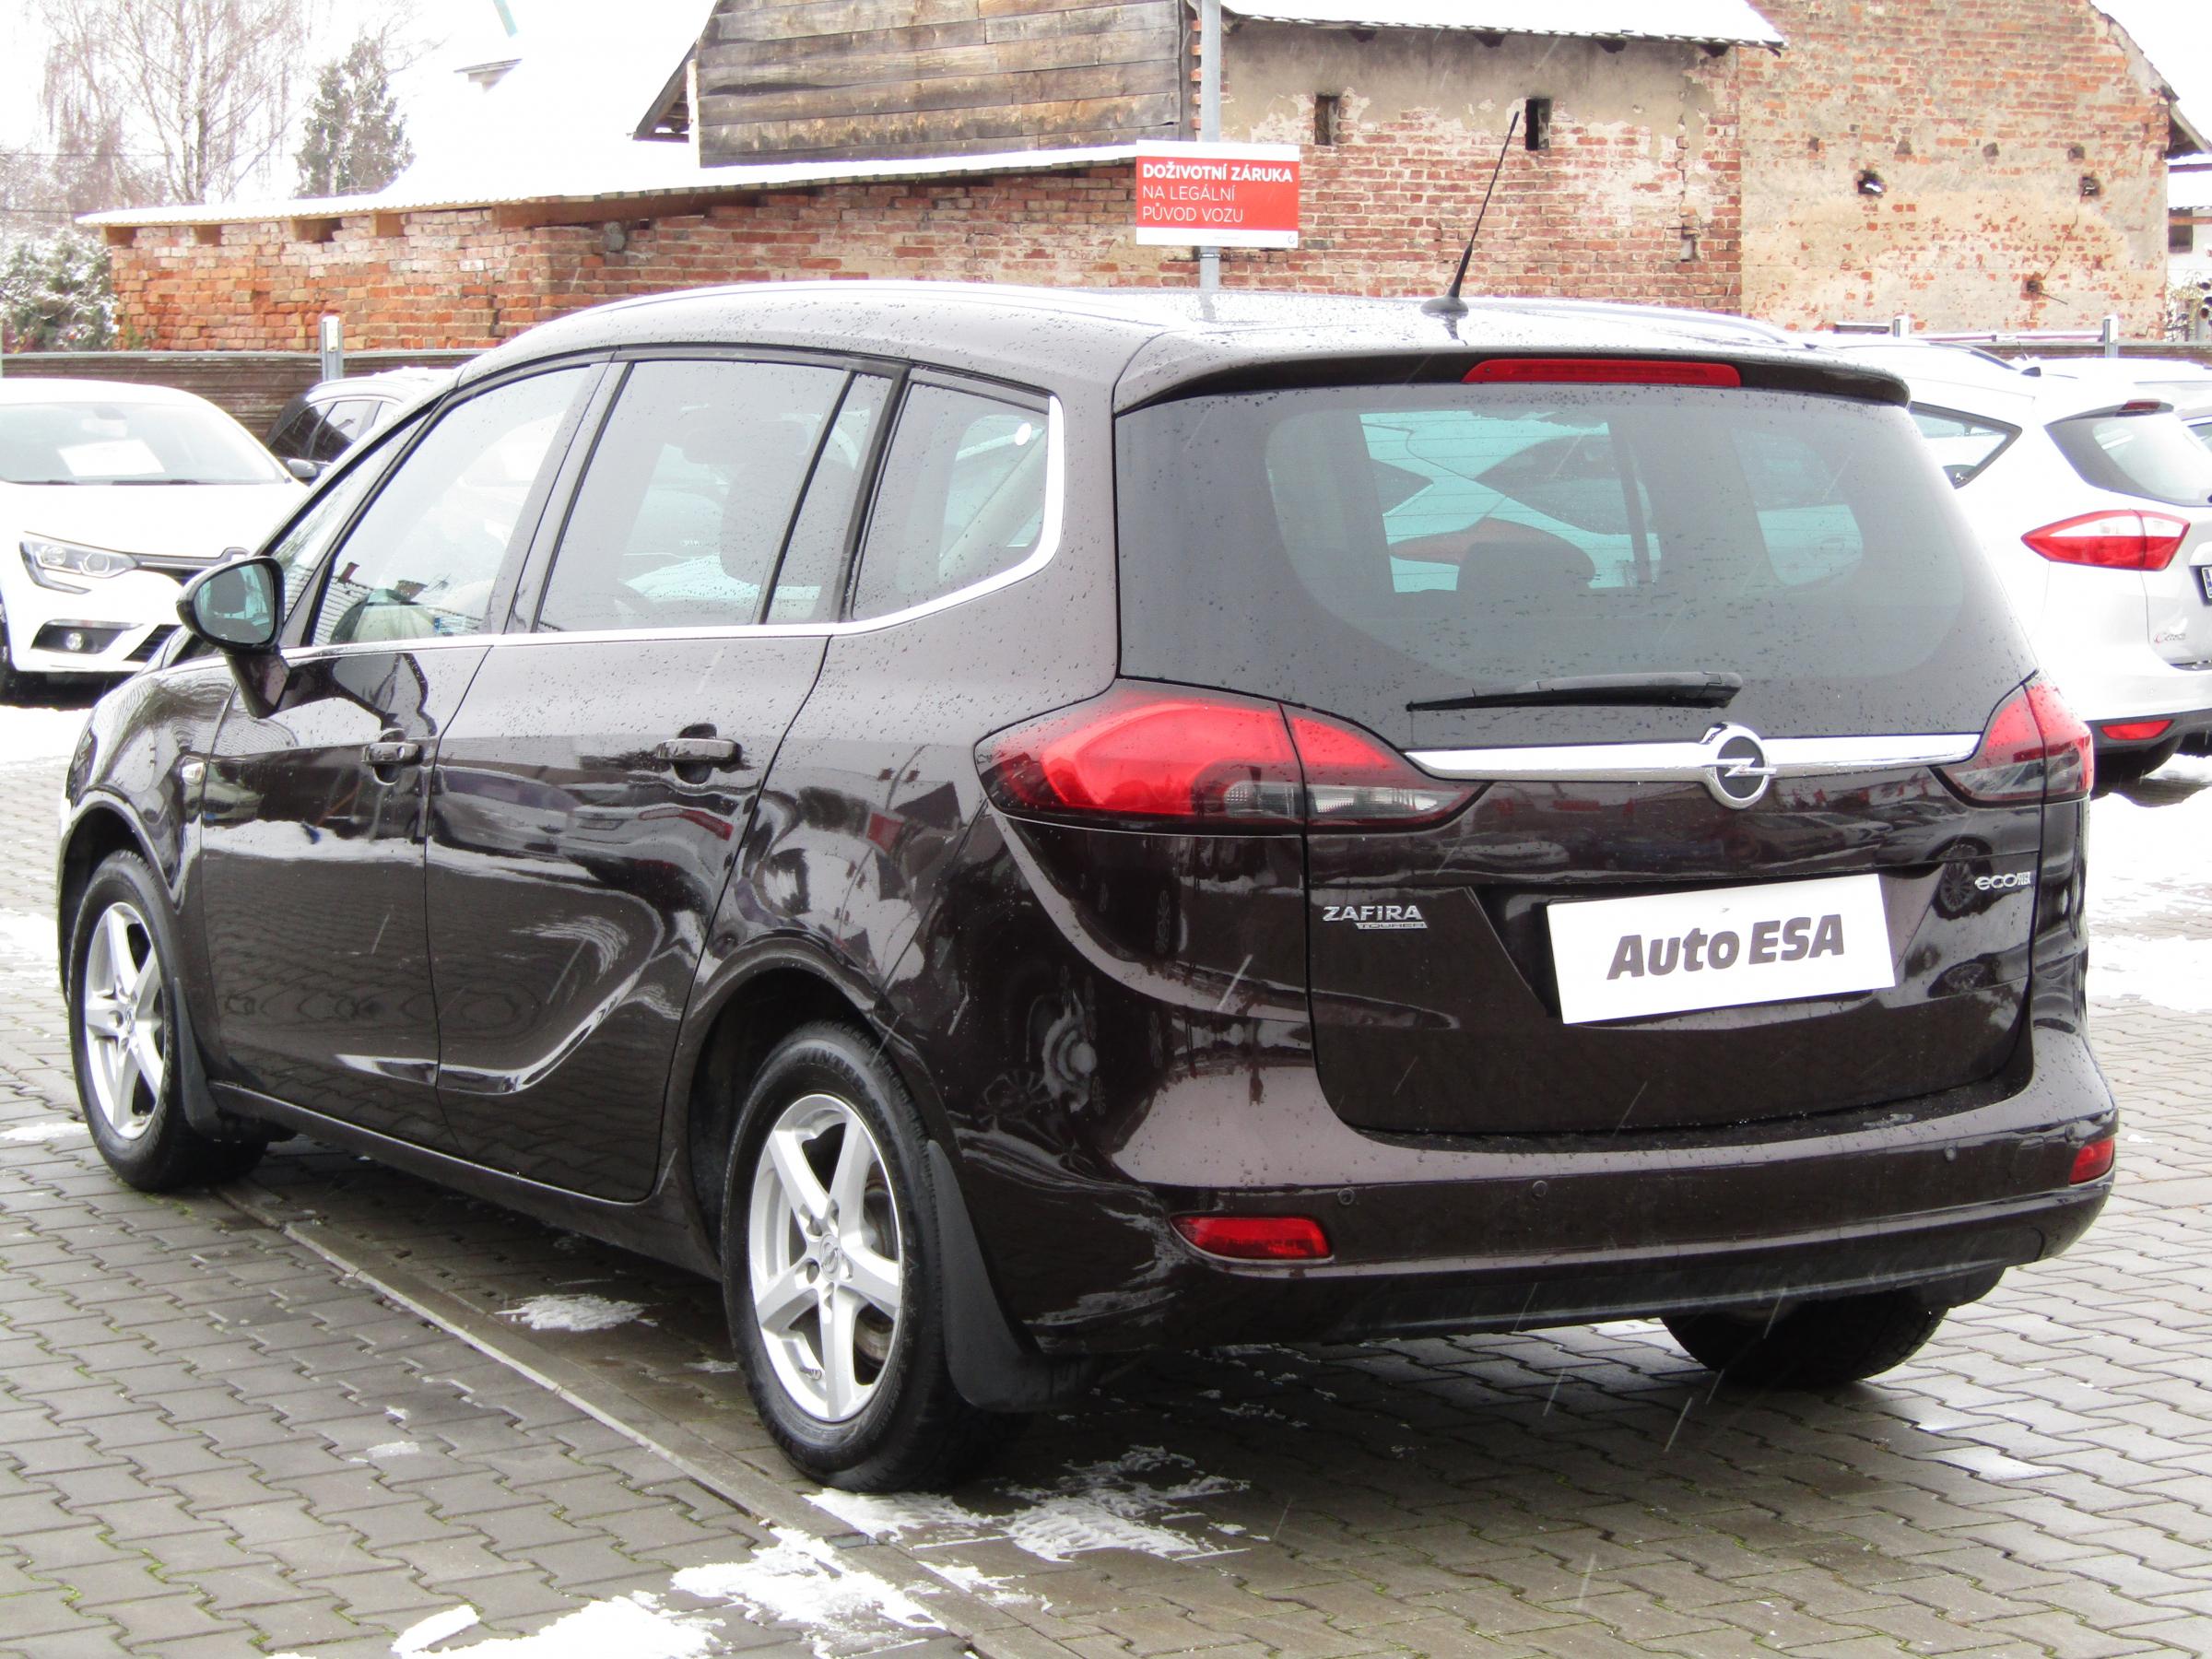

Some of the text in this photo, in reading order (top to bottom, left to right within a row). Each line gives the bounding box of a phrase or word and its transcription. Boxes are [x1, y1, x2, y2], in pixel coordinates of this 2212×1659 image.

[1143, 161, 1293, 182] DOŽIVOTNÍ ZÁRUKA
[1143, 184, 1236, 201] NA LEGÁLNÍ
[1143, 203, 1243, 222] PŮVOD VOZU
[1323, 905, 1423, 922] ZAFIRA
[1606, 913, 1844, 981] Auto ESA
